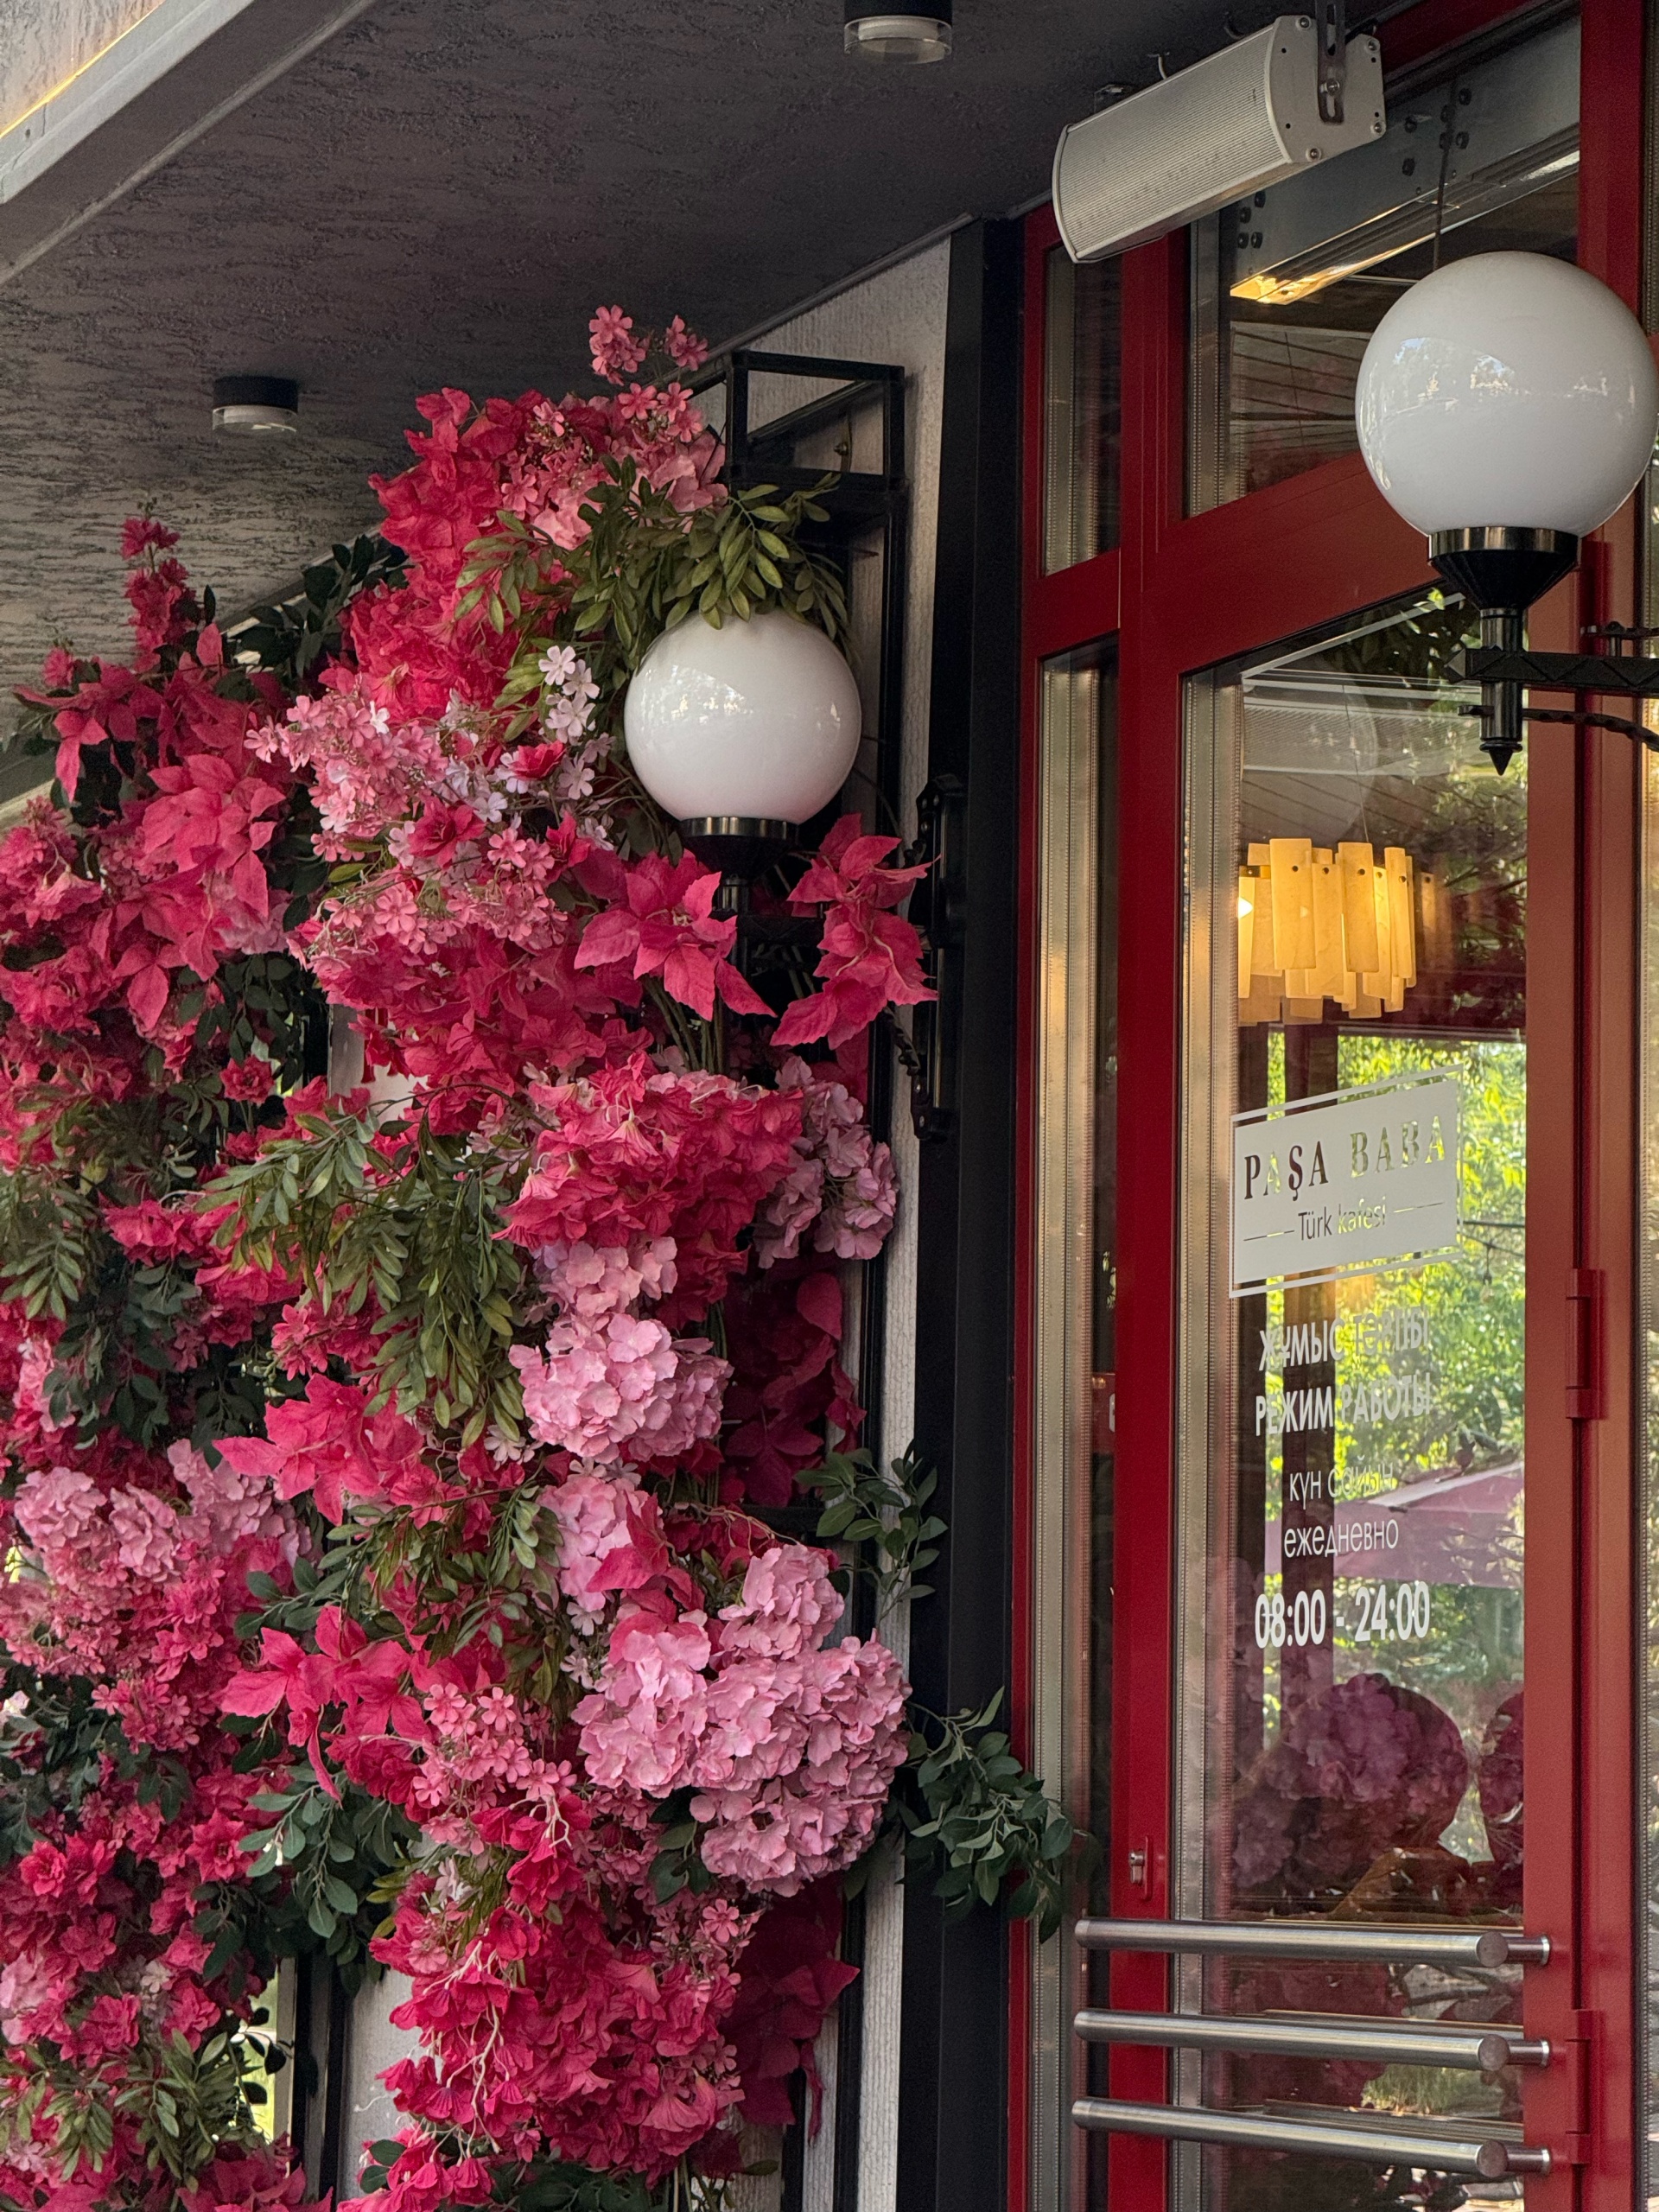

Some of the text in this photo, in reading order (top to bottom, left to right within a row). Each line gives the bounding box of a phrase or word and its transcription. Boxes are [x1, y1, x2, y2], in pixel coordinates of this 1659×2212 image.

[1244, 1116, 1446, 1202] PAŞA BABA
[1298, 1196, 1387, 1241] Türk kafesi
[1259, 1318, 1345, 1371] ЖҰМЫС
[1256, 1372, 1431, 1436] РЕЖИМ РАБОТЫ
[1290, 1454, 1394, 1510] күн сайын
[1284, 1519, 1399, 1558] ежедневно
[1255, 1589, 1326, 1649] 08:00
[1355, 1581, 1430, 1642] 24:00
